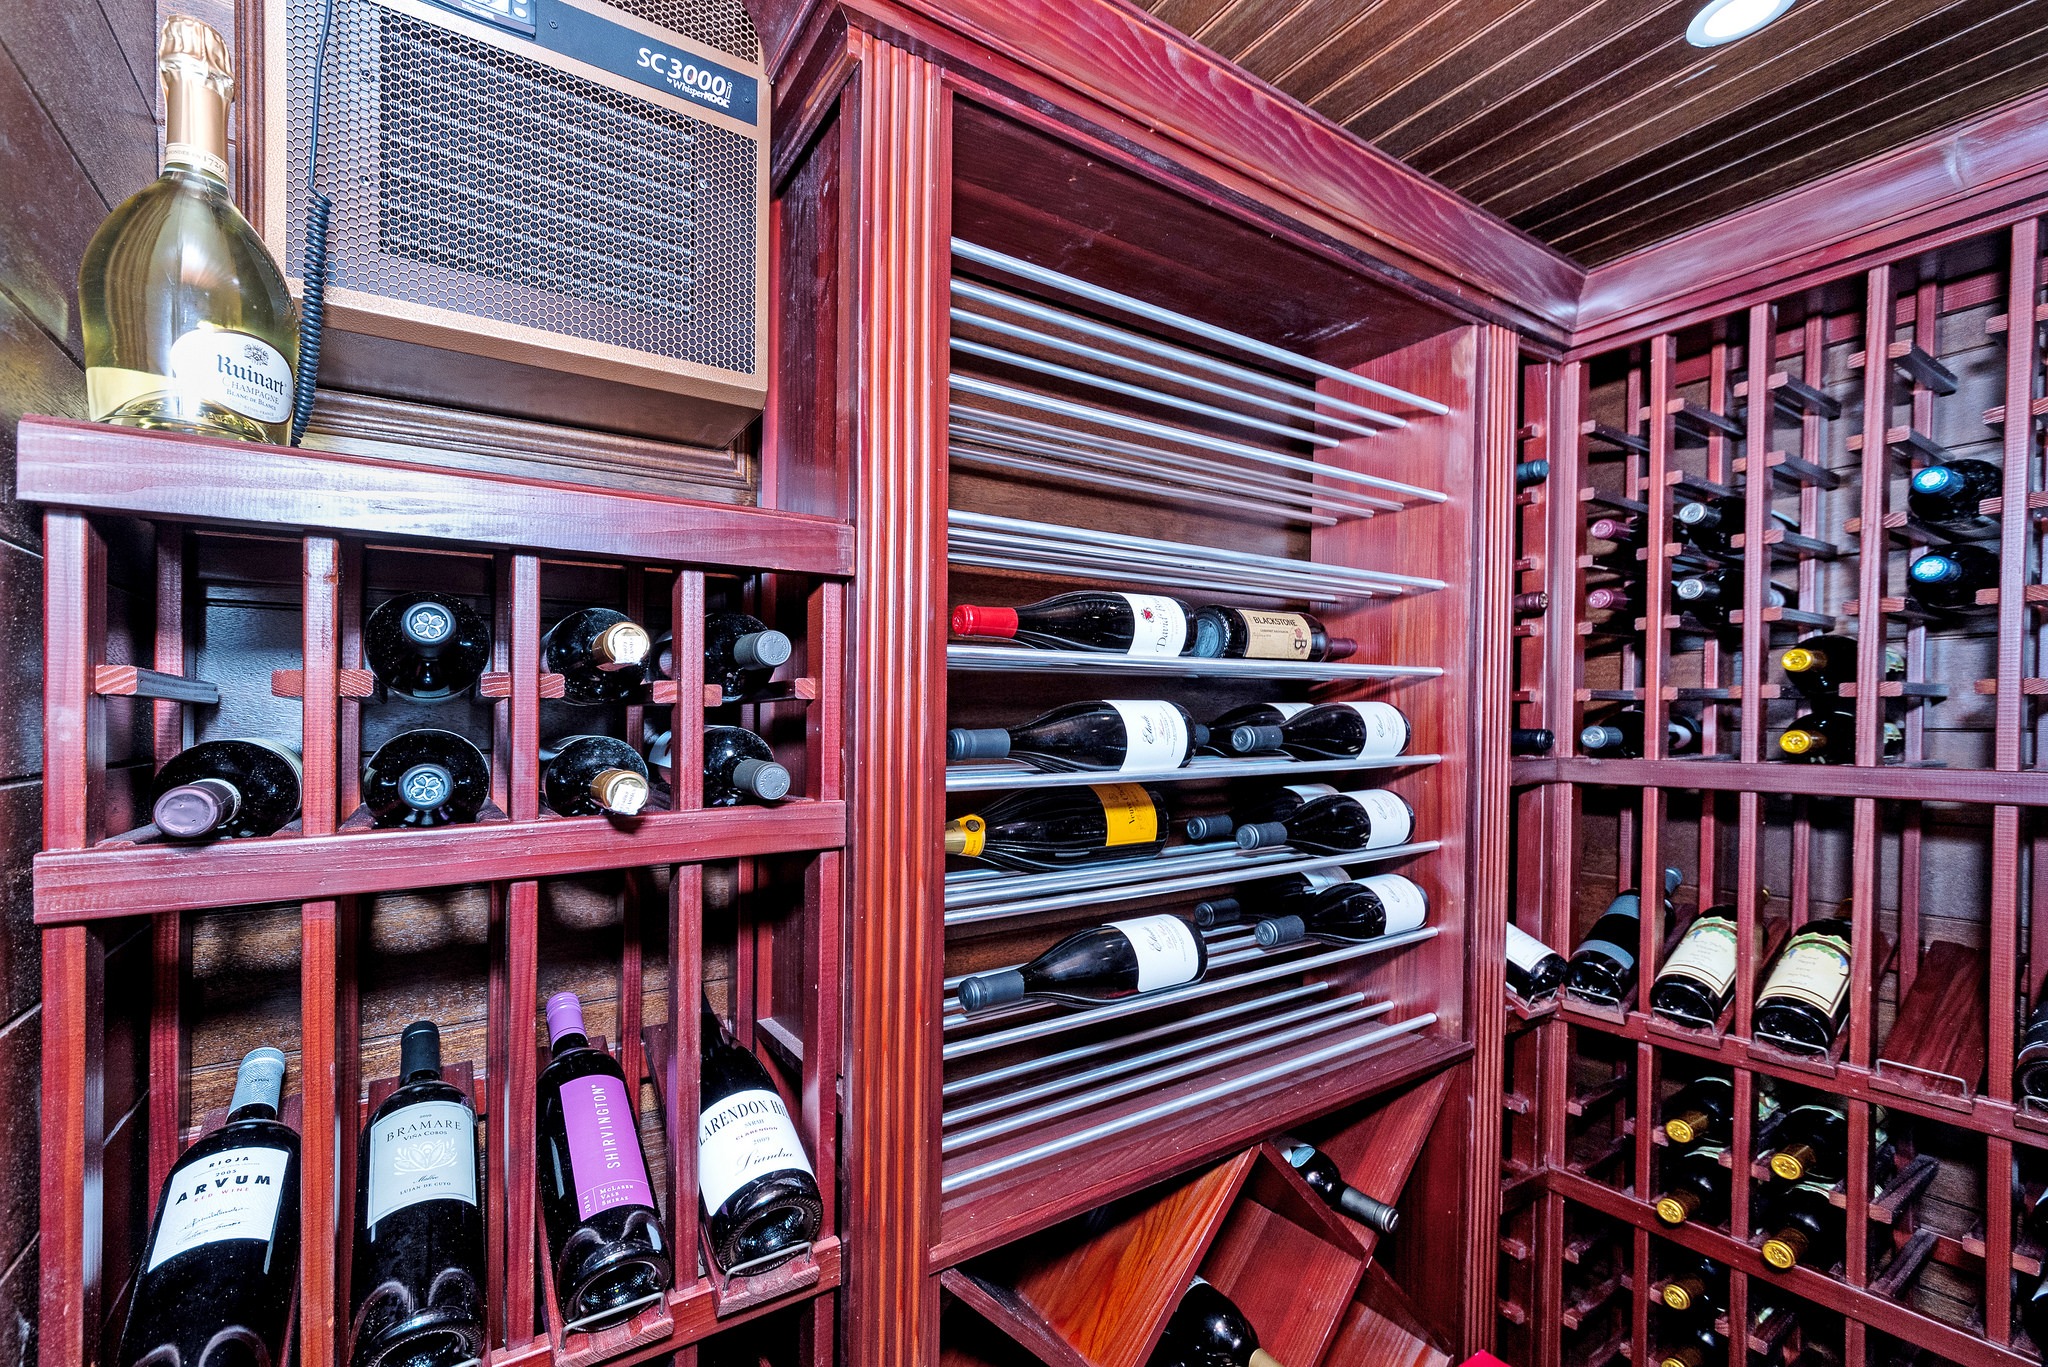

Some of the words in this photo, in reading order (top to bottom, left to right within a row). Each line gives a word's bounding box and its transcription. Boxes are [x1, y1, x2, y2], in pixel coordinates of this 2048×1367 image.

[636, 47, 667, 74] SC
[217, 354, 284, 396] Ruinart
[222, 377, 280, 405] CHAMPAGNE
[1252, 616, 1298, 627] BLACKSTONE
[1294, 639, 1308, 650] B
[386, 1119, 462, 1143] BRAMARE
[592, 1088, 621, 1169] SHIRVINGTON
[699, 1100, 769, 1147] LARENDON
[208, 1156, 249, 1168] RIOJA
[175, 1175, 271, 1206] ARVUM
[193, 1193, 213, 1203] RED
[221, 1187, 249, 1195] WINE
